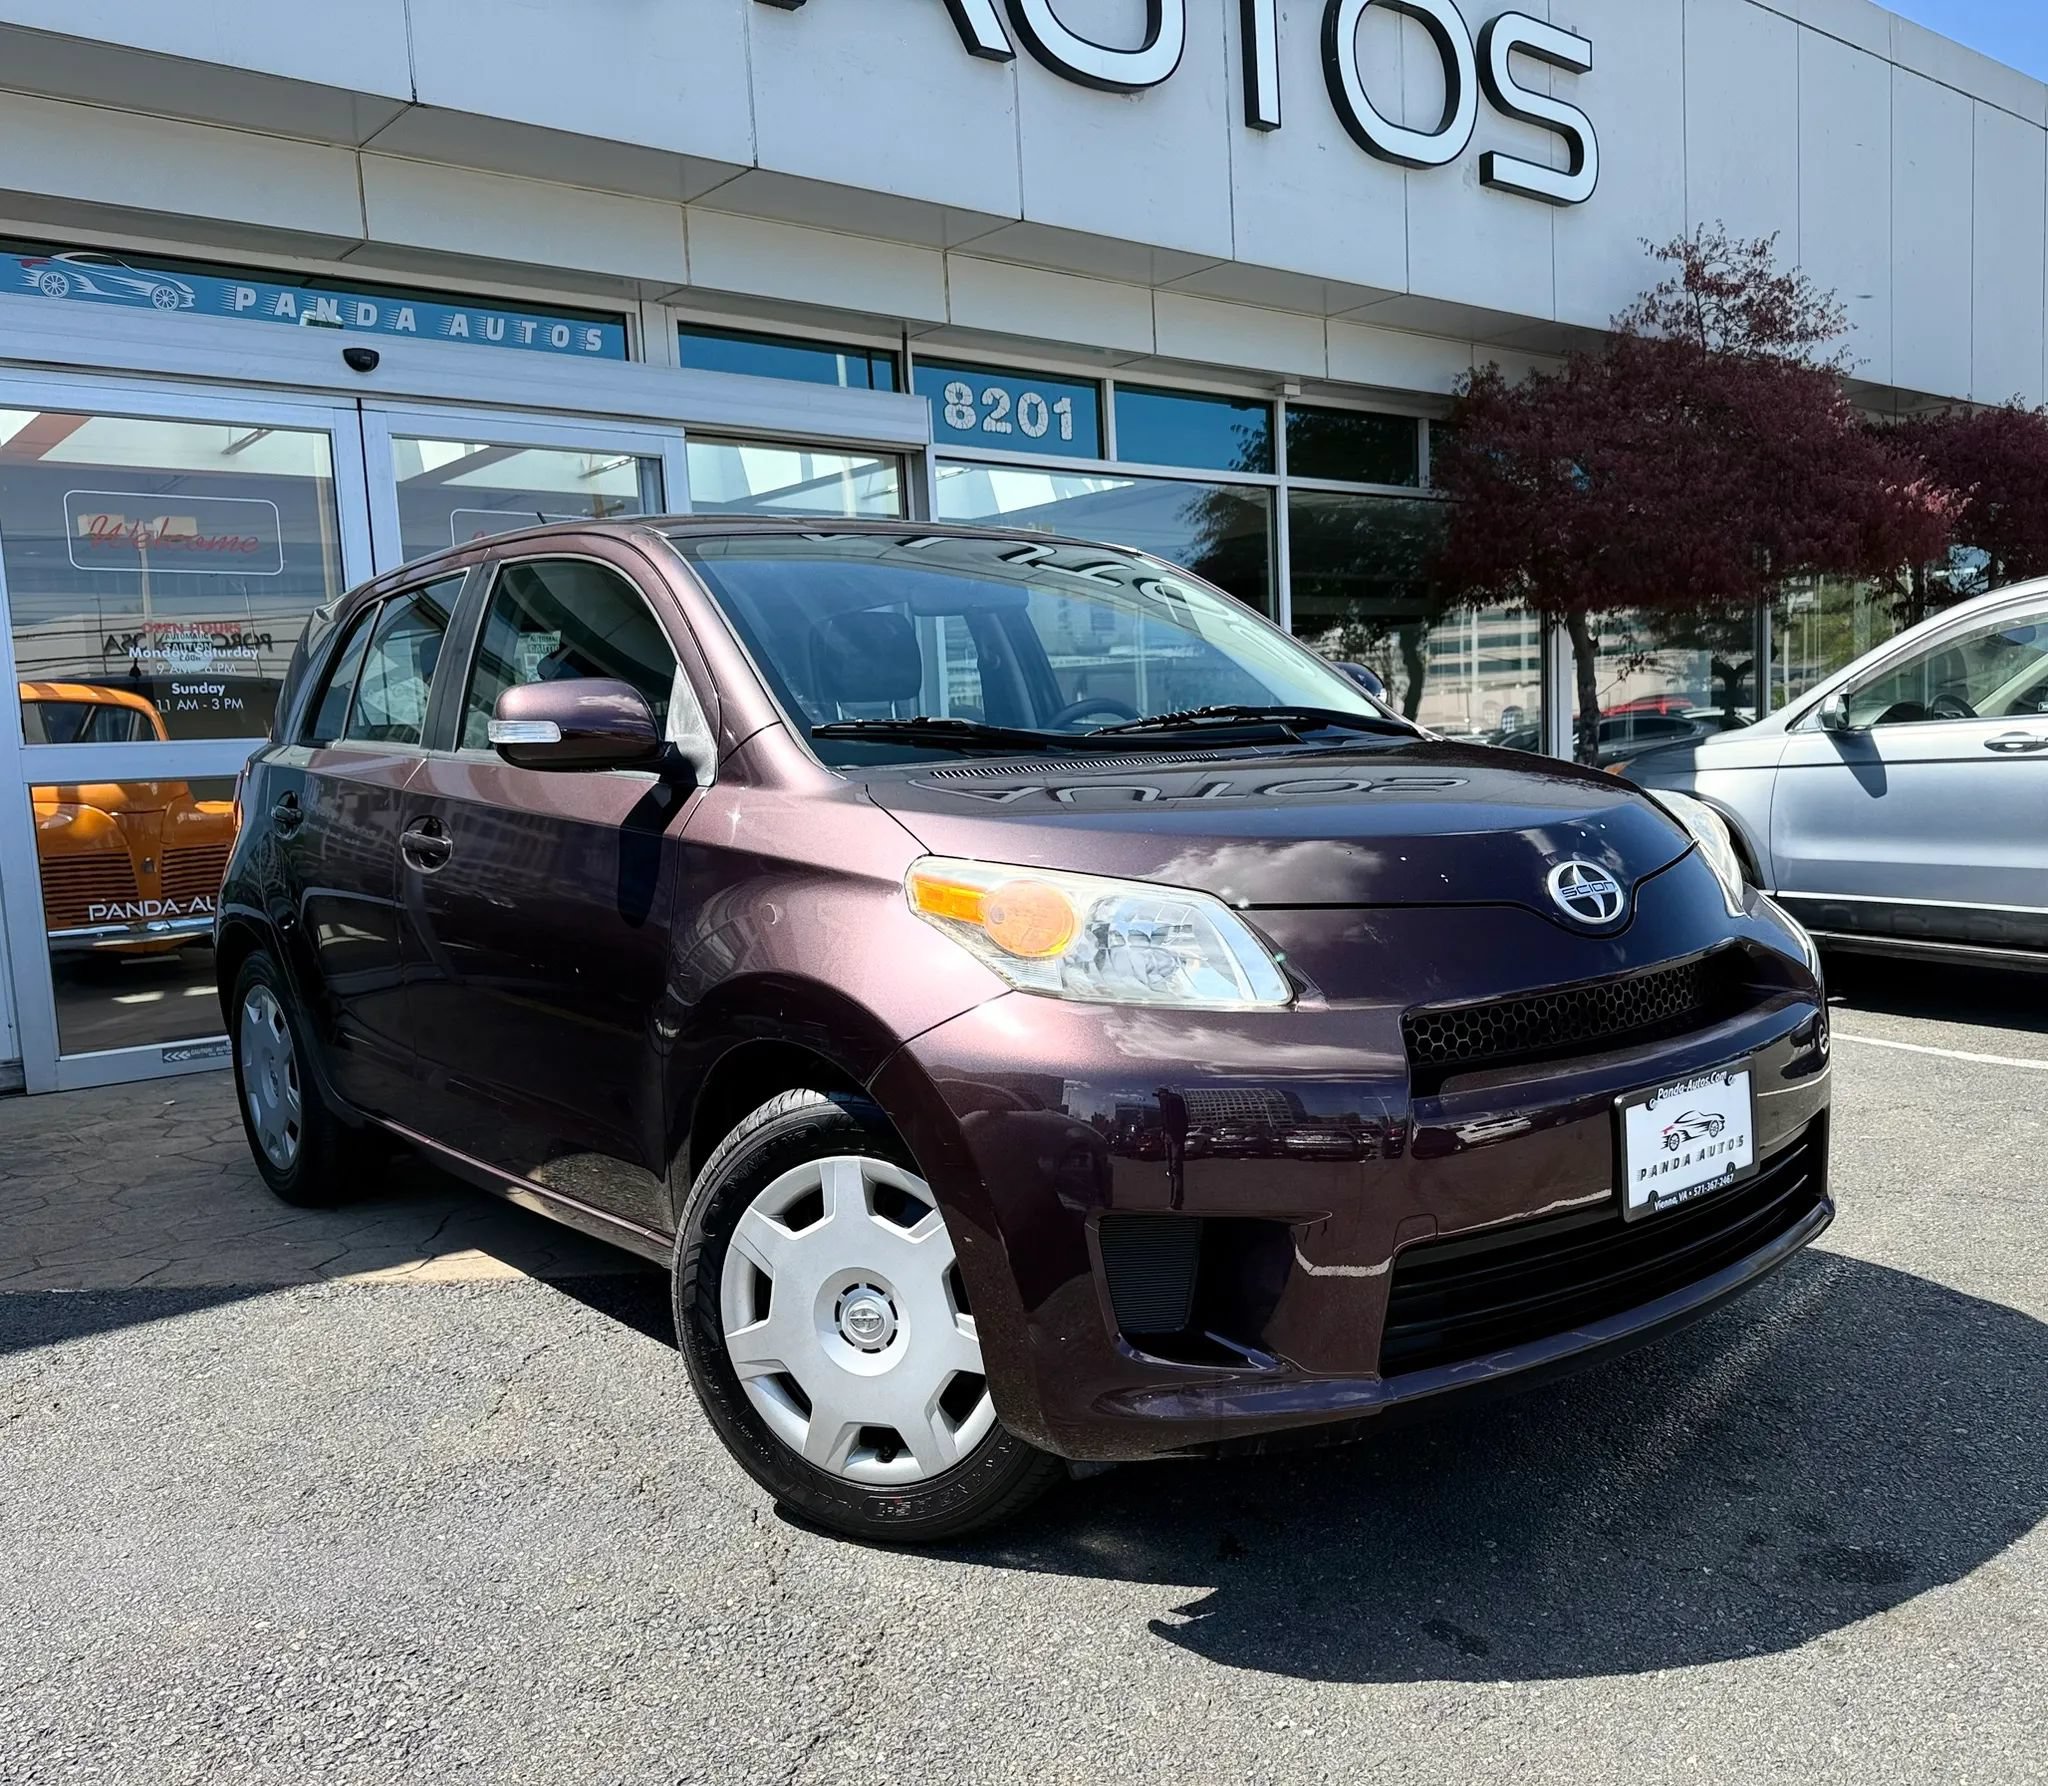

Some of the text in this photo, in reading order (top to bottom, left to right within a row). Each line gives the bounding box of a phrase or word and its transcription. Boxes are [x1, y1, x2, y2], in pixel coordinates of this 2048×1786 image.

[224, 285, 602, 352] PANDA AUTOS
[944, 381, 1073, 441] 8201
[90, 514, 259, 553] Welcome
[142, 622, 241, 634] OPEN HOURS
[156, 664, 164, 675] 9
[204, 664, 213, 674] 6
[216, 664, 237, 674] PM
[172, 682, 225, 696] Sunday
[157, 700, 171, 710] 11
[177, 700, 199, 710] AM
[212, 699, 220, 710] 3
[224, 698, 244, 710] PM
[1562, 881, 1616, 898] SCION
[1657, 1070, 1727, 1100] Panda-Autos.Com
[1638, 1134, 1745, 1182] PANDA AUTOS
[1678, 1190, 1688, 1202] VA
